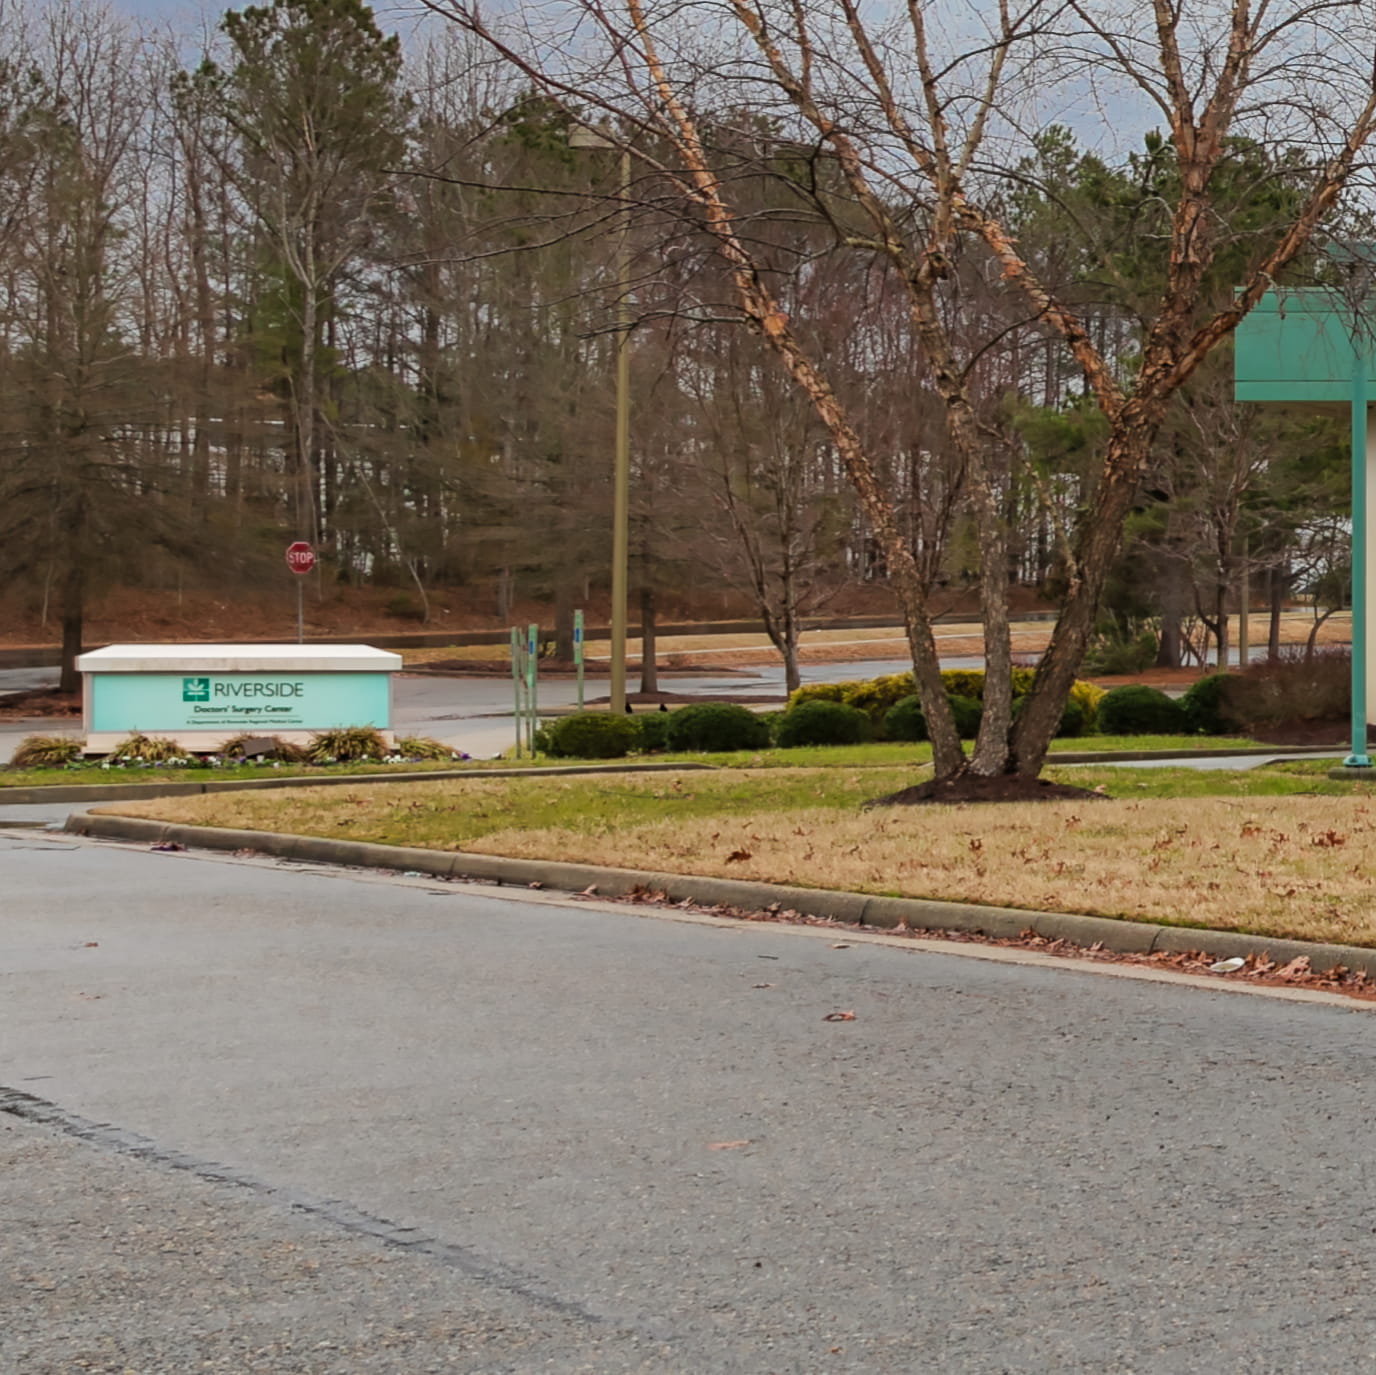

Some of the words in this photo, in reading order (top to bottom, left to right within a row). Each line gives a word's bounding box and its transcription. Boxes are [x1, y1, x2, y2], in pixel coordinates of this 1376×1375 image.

[288, 551, 314, 564] STOP
[214, 682, 304, 697] RIVERSIDE
[232, 704, 262, 714] Surgery
[264, 705, 294, 713] Center
